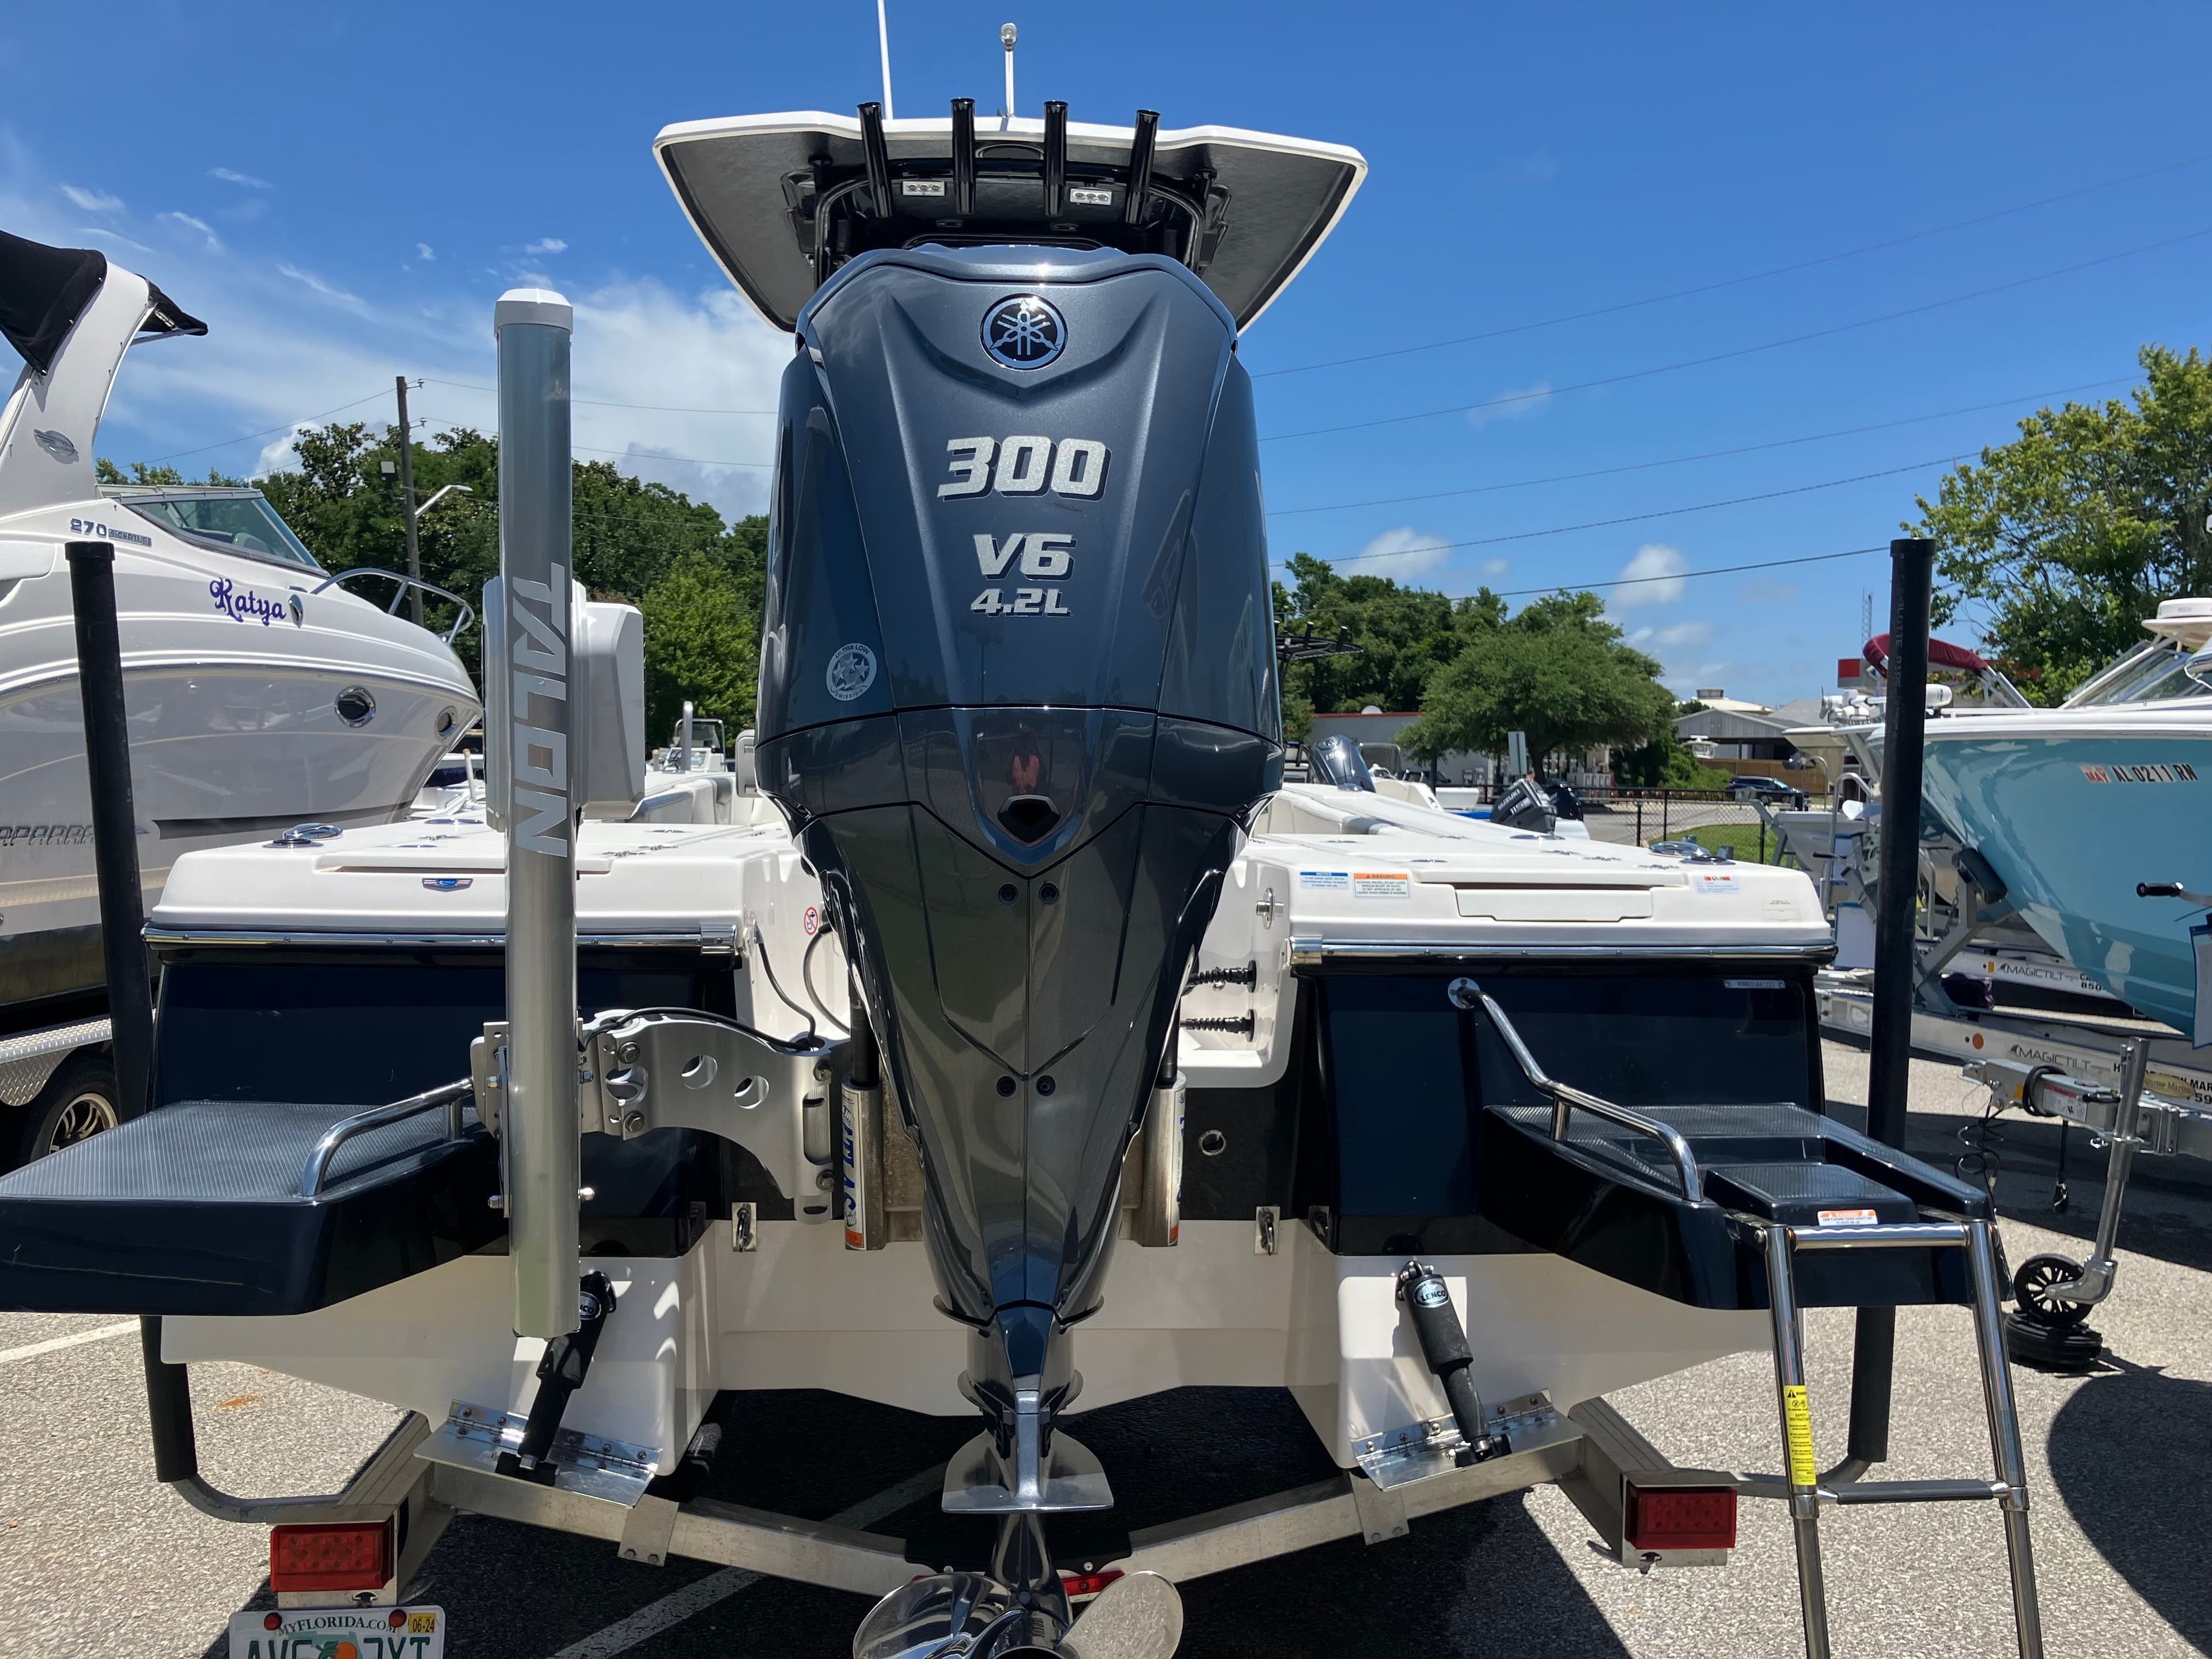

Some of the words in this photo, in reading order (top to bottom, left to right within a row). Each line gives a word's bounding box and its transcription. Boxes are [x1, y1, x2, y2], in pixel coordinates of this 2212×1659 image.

[937, 435, 1112, 502] 300
[70, 518, 107, 539] 270
[972, 532, 1078, 581] V6
[209, 577, 287, 627] Katya
[970, 588, 1072, 618] 4.2L
[512, 562, 568, 858] TALON
[2111, 765, 2134, 782] AL
[2131, 764, 2174, 782] 0211
[2006, 964, 2064, 981] MAGICTILT
[2018, 1048, 2091, 1070] MAGICTILT
[1421, 1290, 1446, 1302] LENCO
[412, 1617, 435, 1633] 06-24
